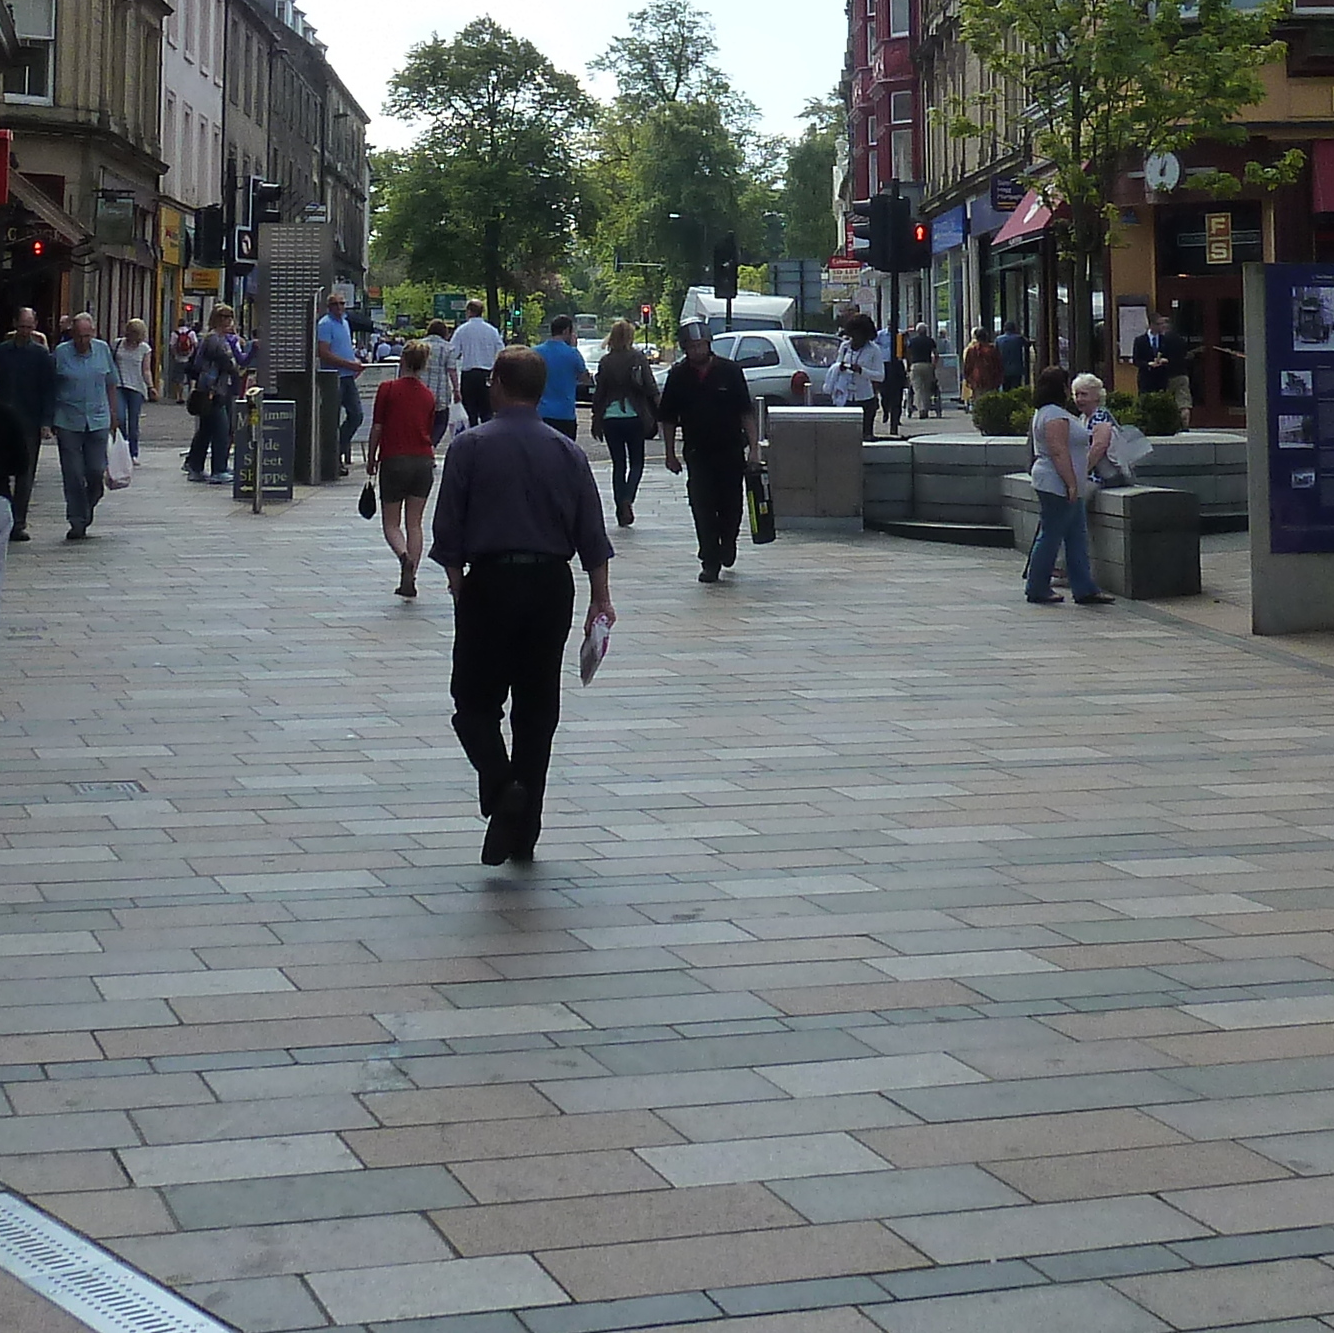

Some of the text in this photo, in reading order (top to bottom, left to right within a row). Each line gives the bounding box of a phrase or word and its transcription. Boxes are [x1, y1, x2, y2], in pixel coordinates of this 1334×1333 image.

[263, 410, 294, 421] imms
[248, 438, 280, 451] Ode
[243, 453, 283, 467] Seet
[239, 469, 289, 484] Shppe
